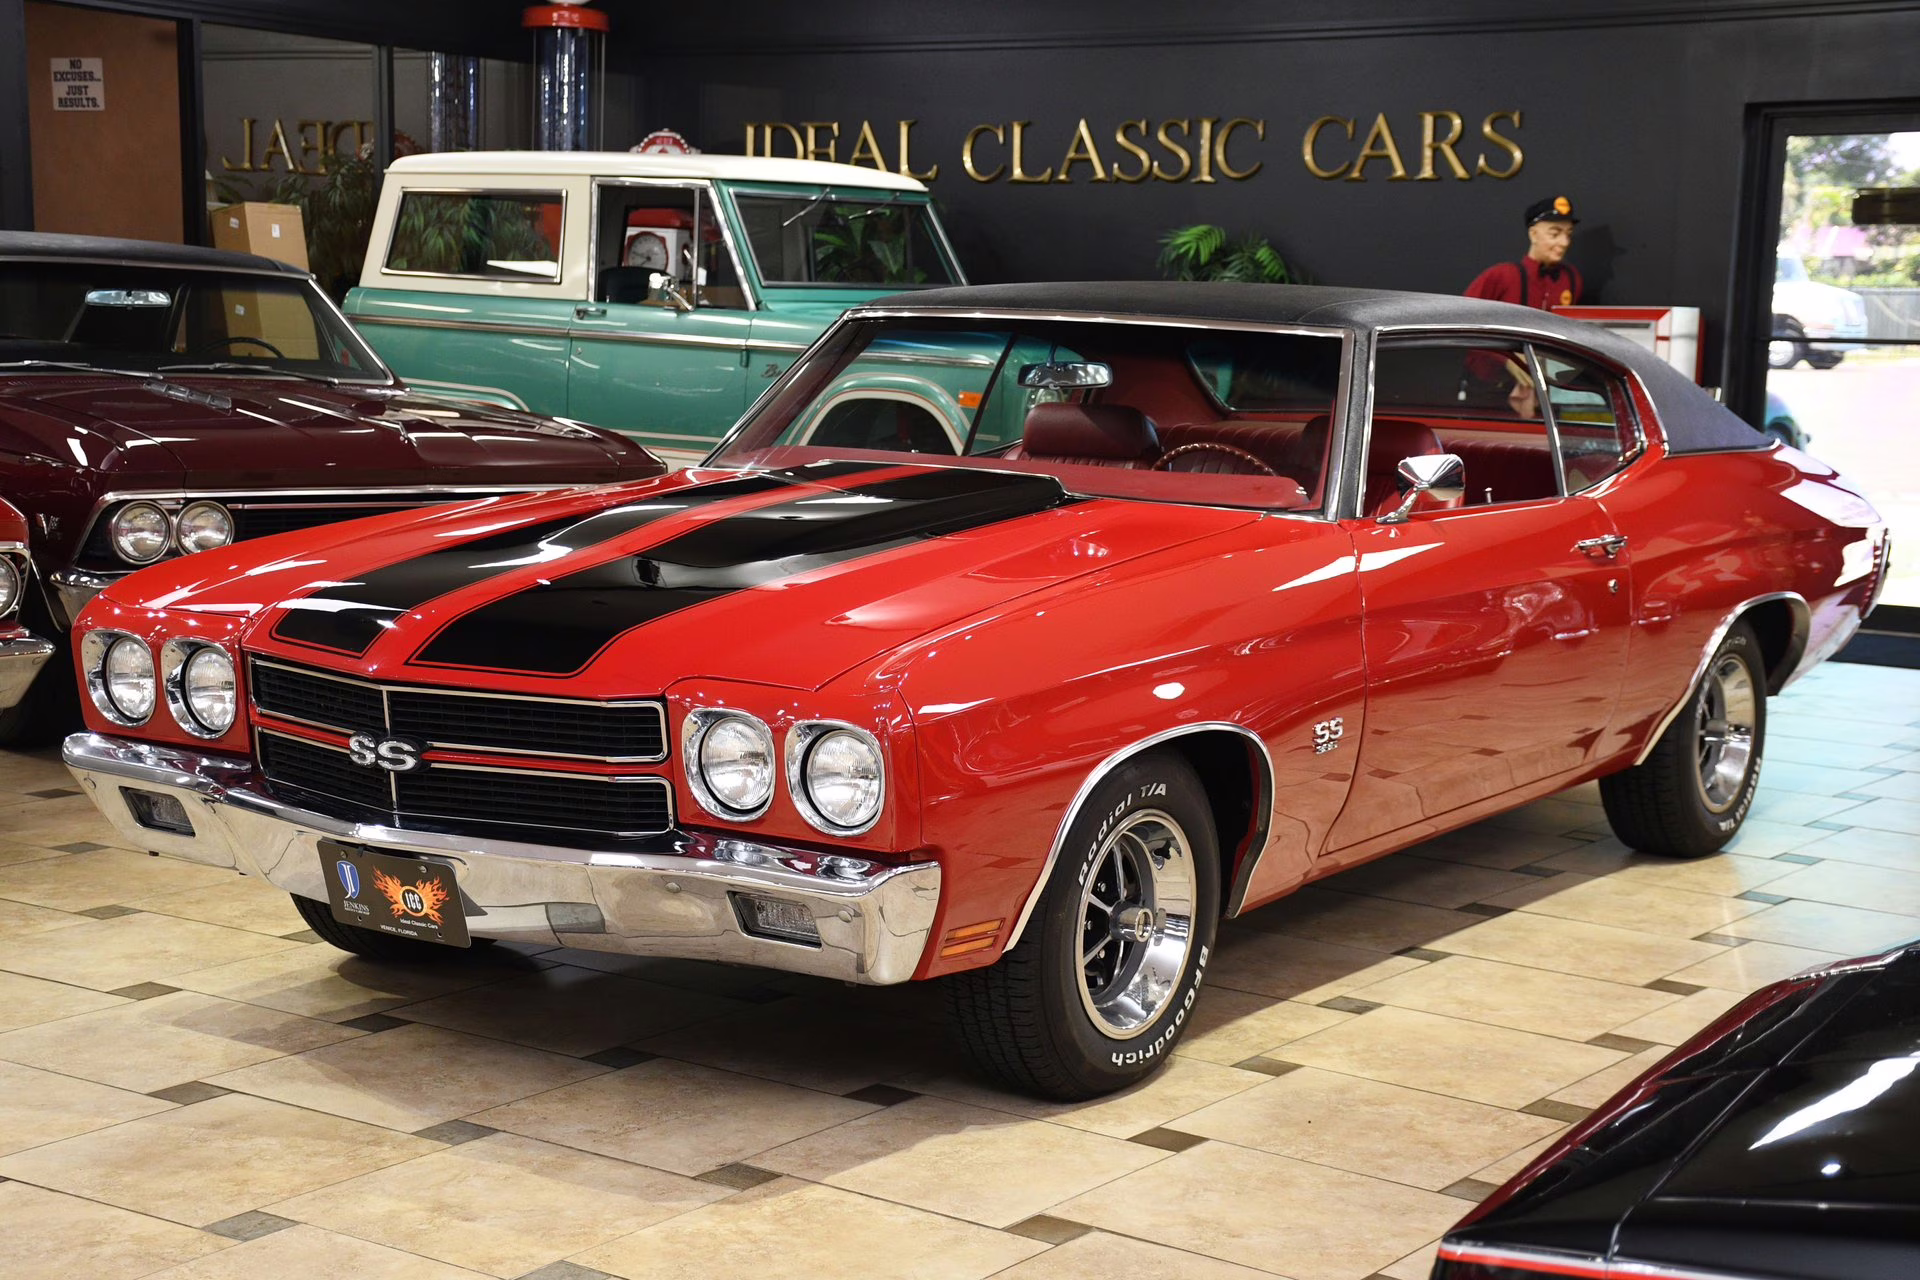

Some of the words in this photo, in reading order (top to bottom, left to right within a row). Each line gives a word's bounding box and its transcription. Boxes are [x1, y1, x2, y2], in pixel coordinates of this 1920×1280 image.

[69, 59, 82, 70] NO
[66, 85, 88, 96] JUST
[57, 97, 99, 108] RESULTS.
[962, 117, 1266, 184] CLASSIC
[1302, 110, 1524, 182] CARS
[1312, 717, 1344, 744] SS
[350, 735, 417, 771] SS
[1078, 793, 1132, 886] Radial
[1140, 782, 1167, 798] T/A
[405, 892, 422, 911] ICC
[398, 928, 418, 936] FLORIDA
[1111, 945, 1209, 1067] BFGoodrich
